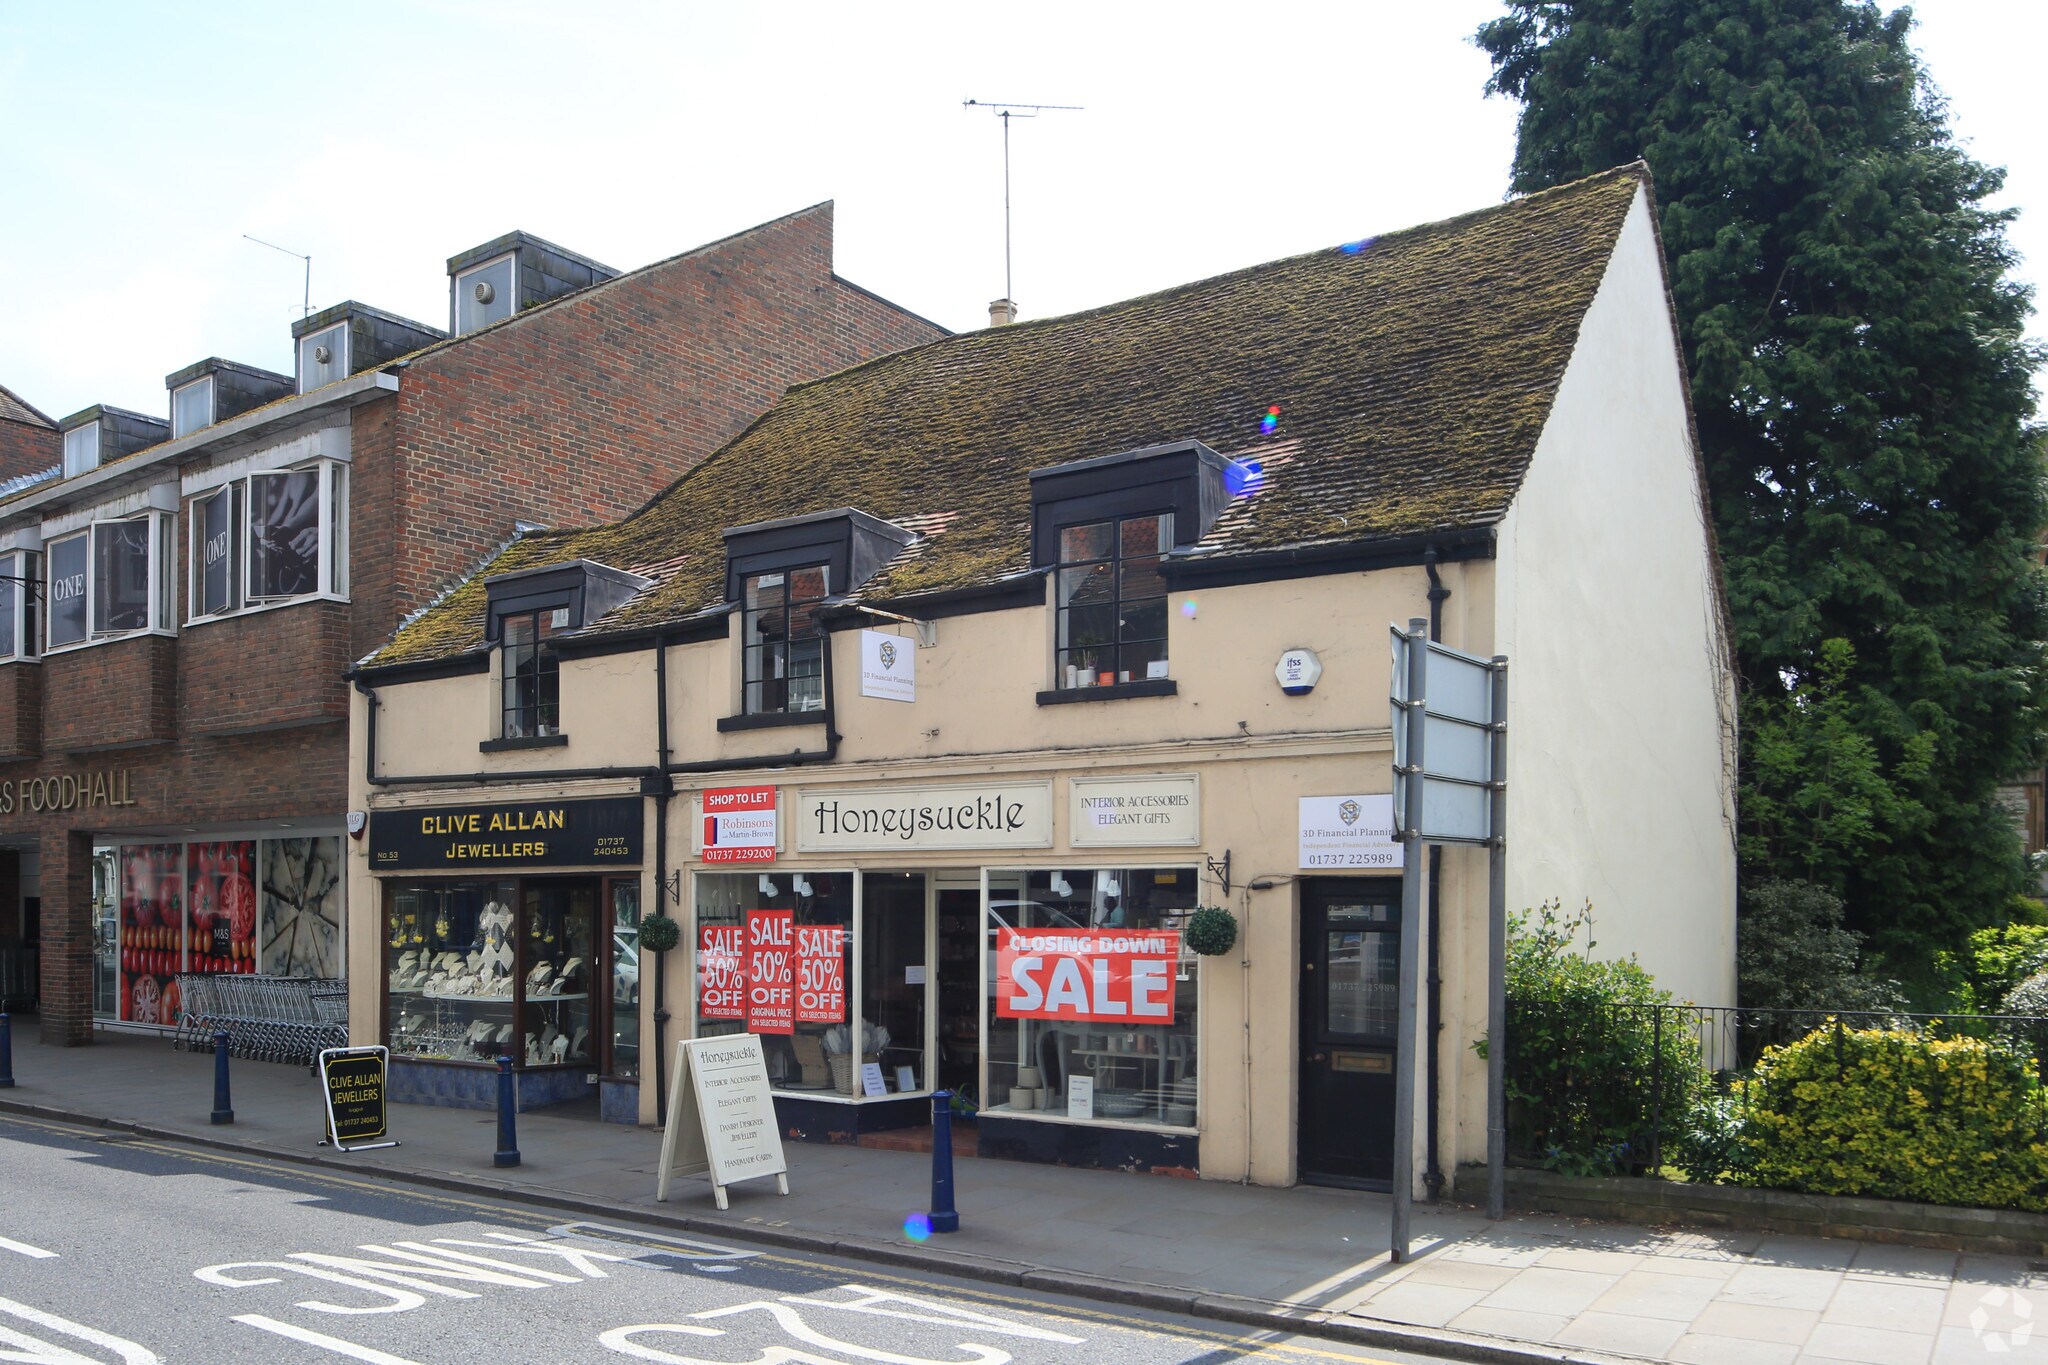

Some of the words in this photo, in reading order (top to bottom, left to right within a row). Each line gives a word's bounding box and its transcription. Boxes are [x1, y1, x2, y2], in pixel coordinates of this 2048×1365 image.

[207, 531, 226, 565] ONE
[54, 574, 84, 601] ONE
[20, 769, 135, 812] FOODHALL
[709, 794, 734, 806] SHOP
[736, 793, 749, 804] TO
[751, 792, 768, 803] LET
[1081, 796, 1125, 809] INTERIOR
[1128, 795, 1189, 807] ACCESSORIES
[422, 814, 480, 834] CLIVE
[489, 810, 564, 831] ALLAN
[722, 818, 773, 829] Robinsons
[815, 794, 1025, 840] Honeysuckle
[1098, 813, 1142, 825] ELEGANT
[1144, 813, 1171, 824] GIFTS
[1303, 830, 1315, 838] 3D
[1317, 828, 1357, 837] Financial
[597, 838, 625, 846] 01737
[446, 842, 545, 859] JEWELLERS
[594, 847, 628, 856] 240453
[706, 850, 733, 860] 01737
[736, 849, 772, 859] 229200
[1309, 855, 1344, 864] 01737
[1349, 854, 1393, 864] 225989
[214, 929, 229, 939] M&S
[750, 917, 791, 946] SALE
[704, 929, 743, 957] SALE
[798, 929, 841, 957] SALE
[1009, 935, 1092, 952] CLOSING
[1099, 937, 1166, 954] DOWN
[704, 958, 743, 989] 50%
[751, 951, 791, 983] 50%
[800, 959, 842, 991] 50%
[1009, 957, 1168, 1016] SALE
[704, 990, 743, 1006] OFF
[750, 987, 791, 1004] OFF
[800, 992, 842, 1009] OFF
[730, 1008, 742, 1016] ITEMS
[751, 1007, 776, 1017] ORIGINAL
[777, 1008, 791, 1018] PRICE
[800, 1011, 808, 1019] ON
[808, 1011, 828, 1019] SELECTED
[760, 1019, 778, 1027] SELECTED
[779, 1020, 791, 1028] ITEMS
[701, 1046, 757, 1064] Honeysuckle
[330, 1075, 353, 1089] CLIVE
[354, 1073, 380, 1086] ALLAN
[704, 1078, 728, 1088] INTERIOR
[729, 1075, 761, 1085] ACCESSORIES
[333, 1088, 379, 1104] JEWELLERS
[717, 1097, 741, 1107] ELEGANT
[344, 1118, 359, 1126] 01737
[361, 1116, 379, 1124] 240453
[720, 1123, 739, 1132] DANISH
[739, 1118, 764, 1129] DESIGNER
[731, 1131, 757, 1142] JEWELLERY
[724, 1155, 755, 1168] HANDMADE
[755, 1153, 773, 1162] CARDS
